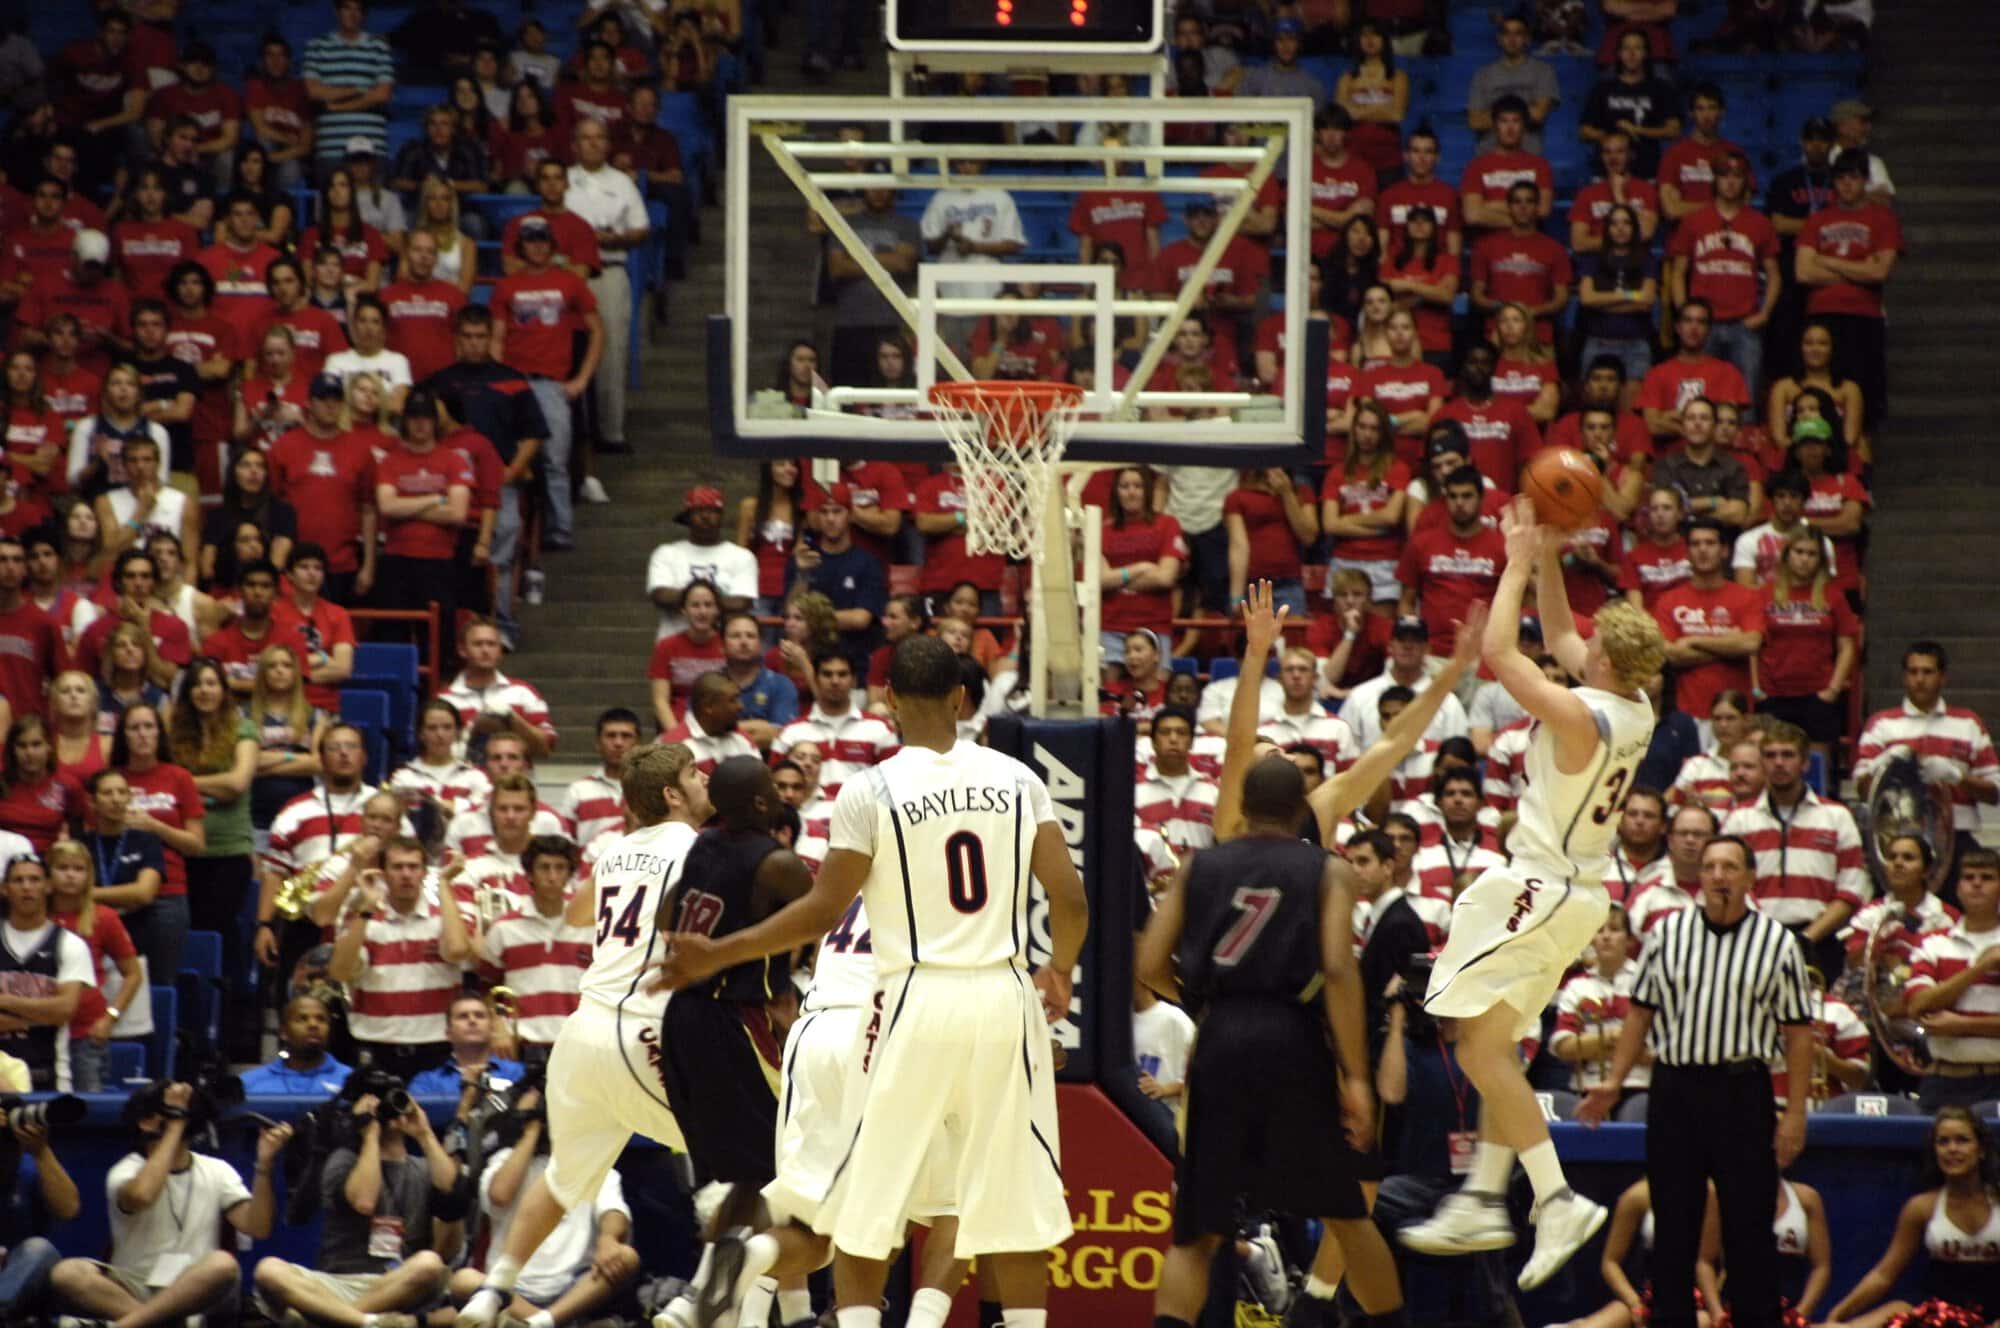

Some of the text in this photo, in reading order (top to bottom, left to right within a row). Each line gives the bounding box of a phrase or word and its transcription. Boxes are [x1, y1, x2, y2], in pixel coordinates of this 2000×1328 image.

[902, 786, 1010, 825] BAYLESS
[1593, 767, 1628, 824] 3
[600, 853, 668, 876] WALTERS
[944, 829, 988, 915] 0
[596, 884, 649, 947] 54
[825, 894, 873, 954] 4
[1212, 886, 1283, 967] 7
[1506, 878, 1543, 932] CATS
[639, 1026, 668, 1090] CAT
[863, 989, 886, 1074] CATS
